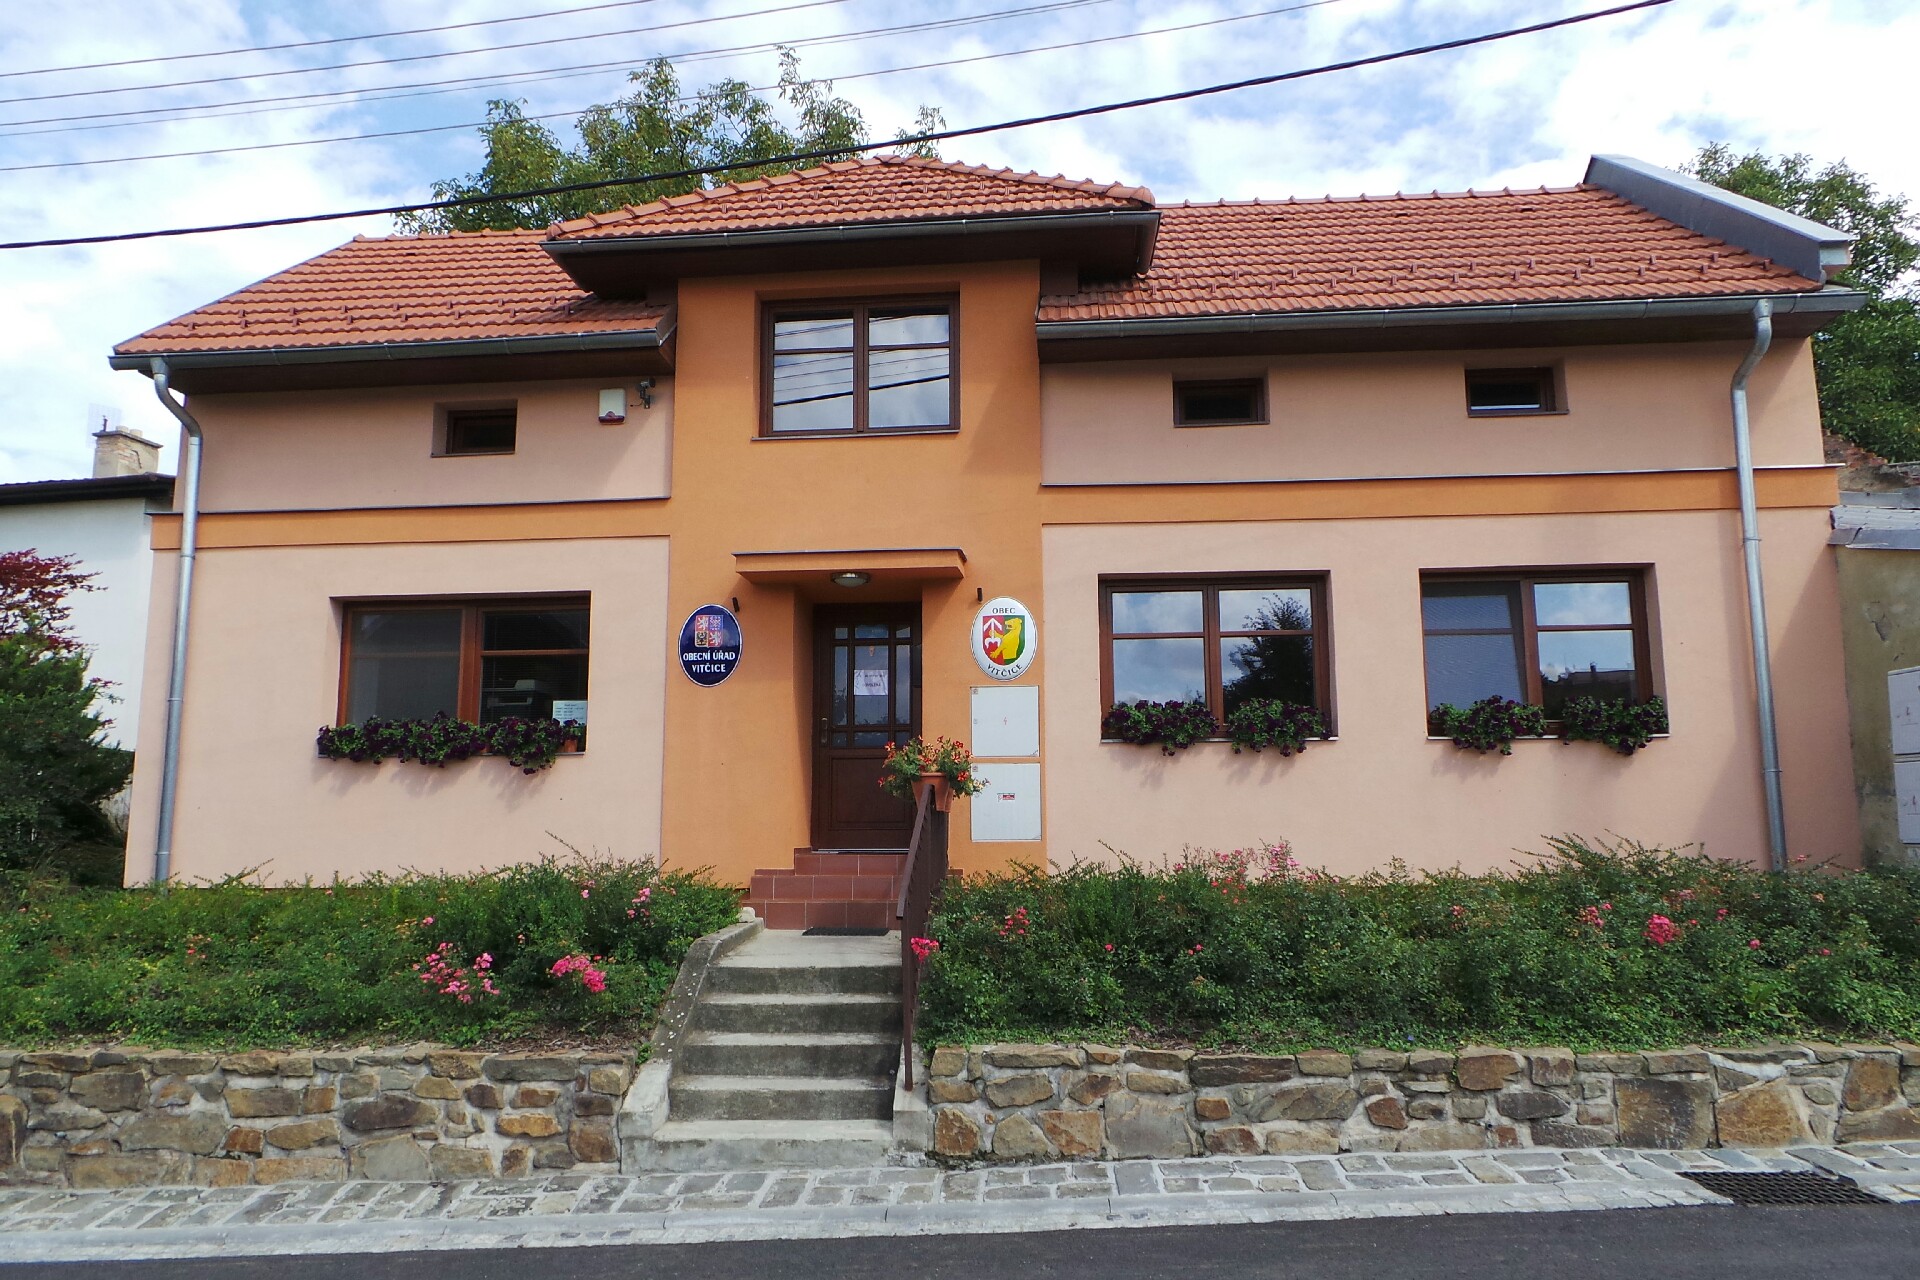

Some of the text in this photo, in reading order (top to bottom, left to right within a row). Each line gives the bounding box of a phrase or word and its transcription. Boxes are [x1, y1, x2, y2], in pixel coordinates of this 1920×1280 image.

[683, 650, 735, 660] OBECNÍ ÚŘAD
[692, 663, 726, 673] VITČICE
[987, 663, 1023, 677] VITČICE
